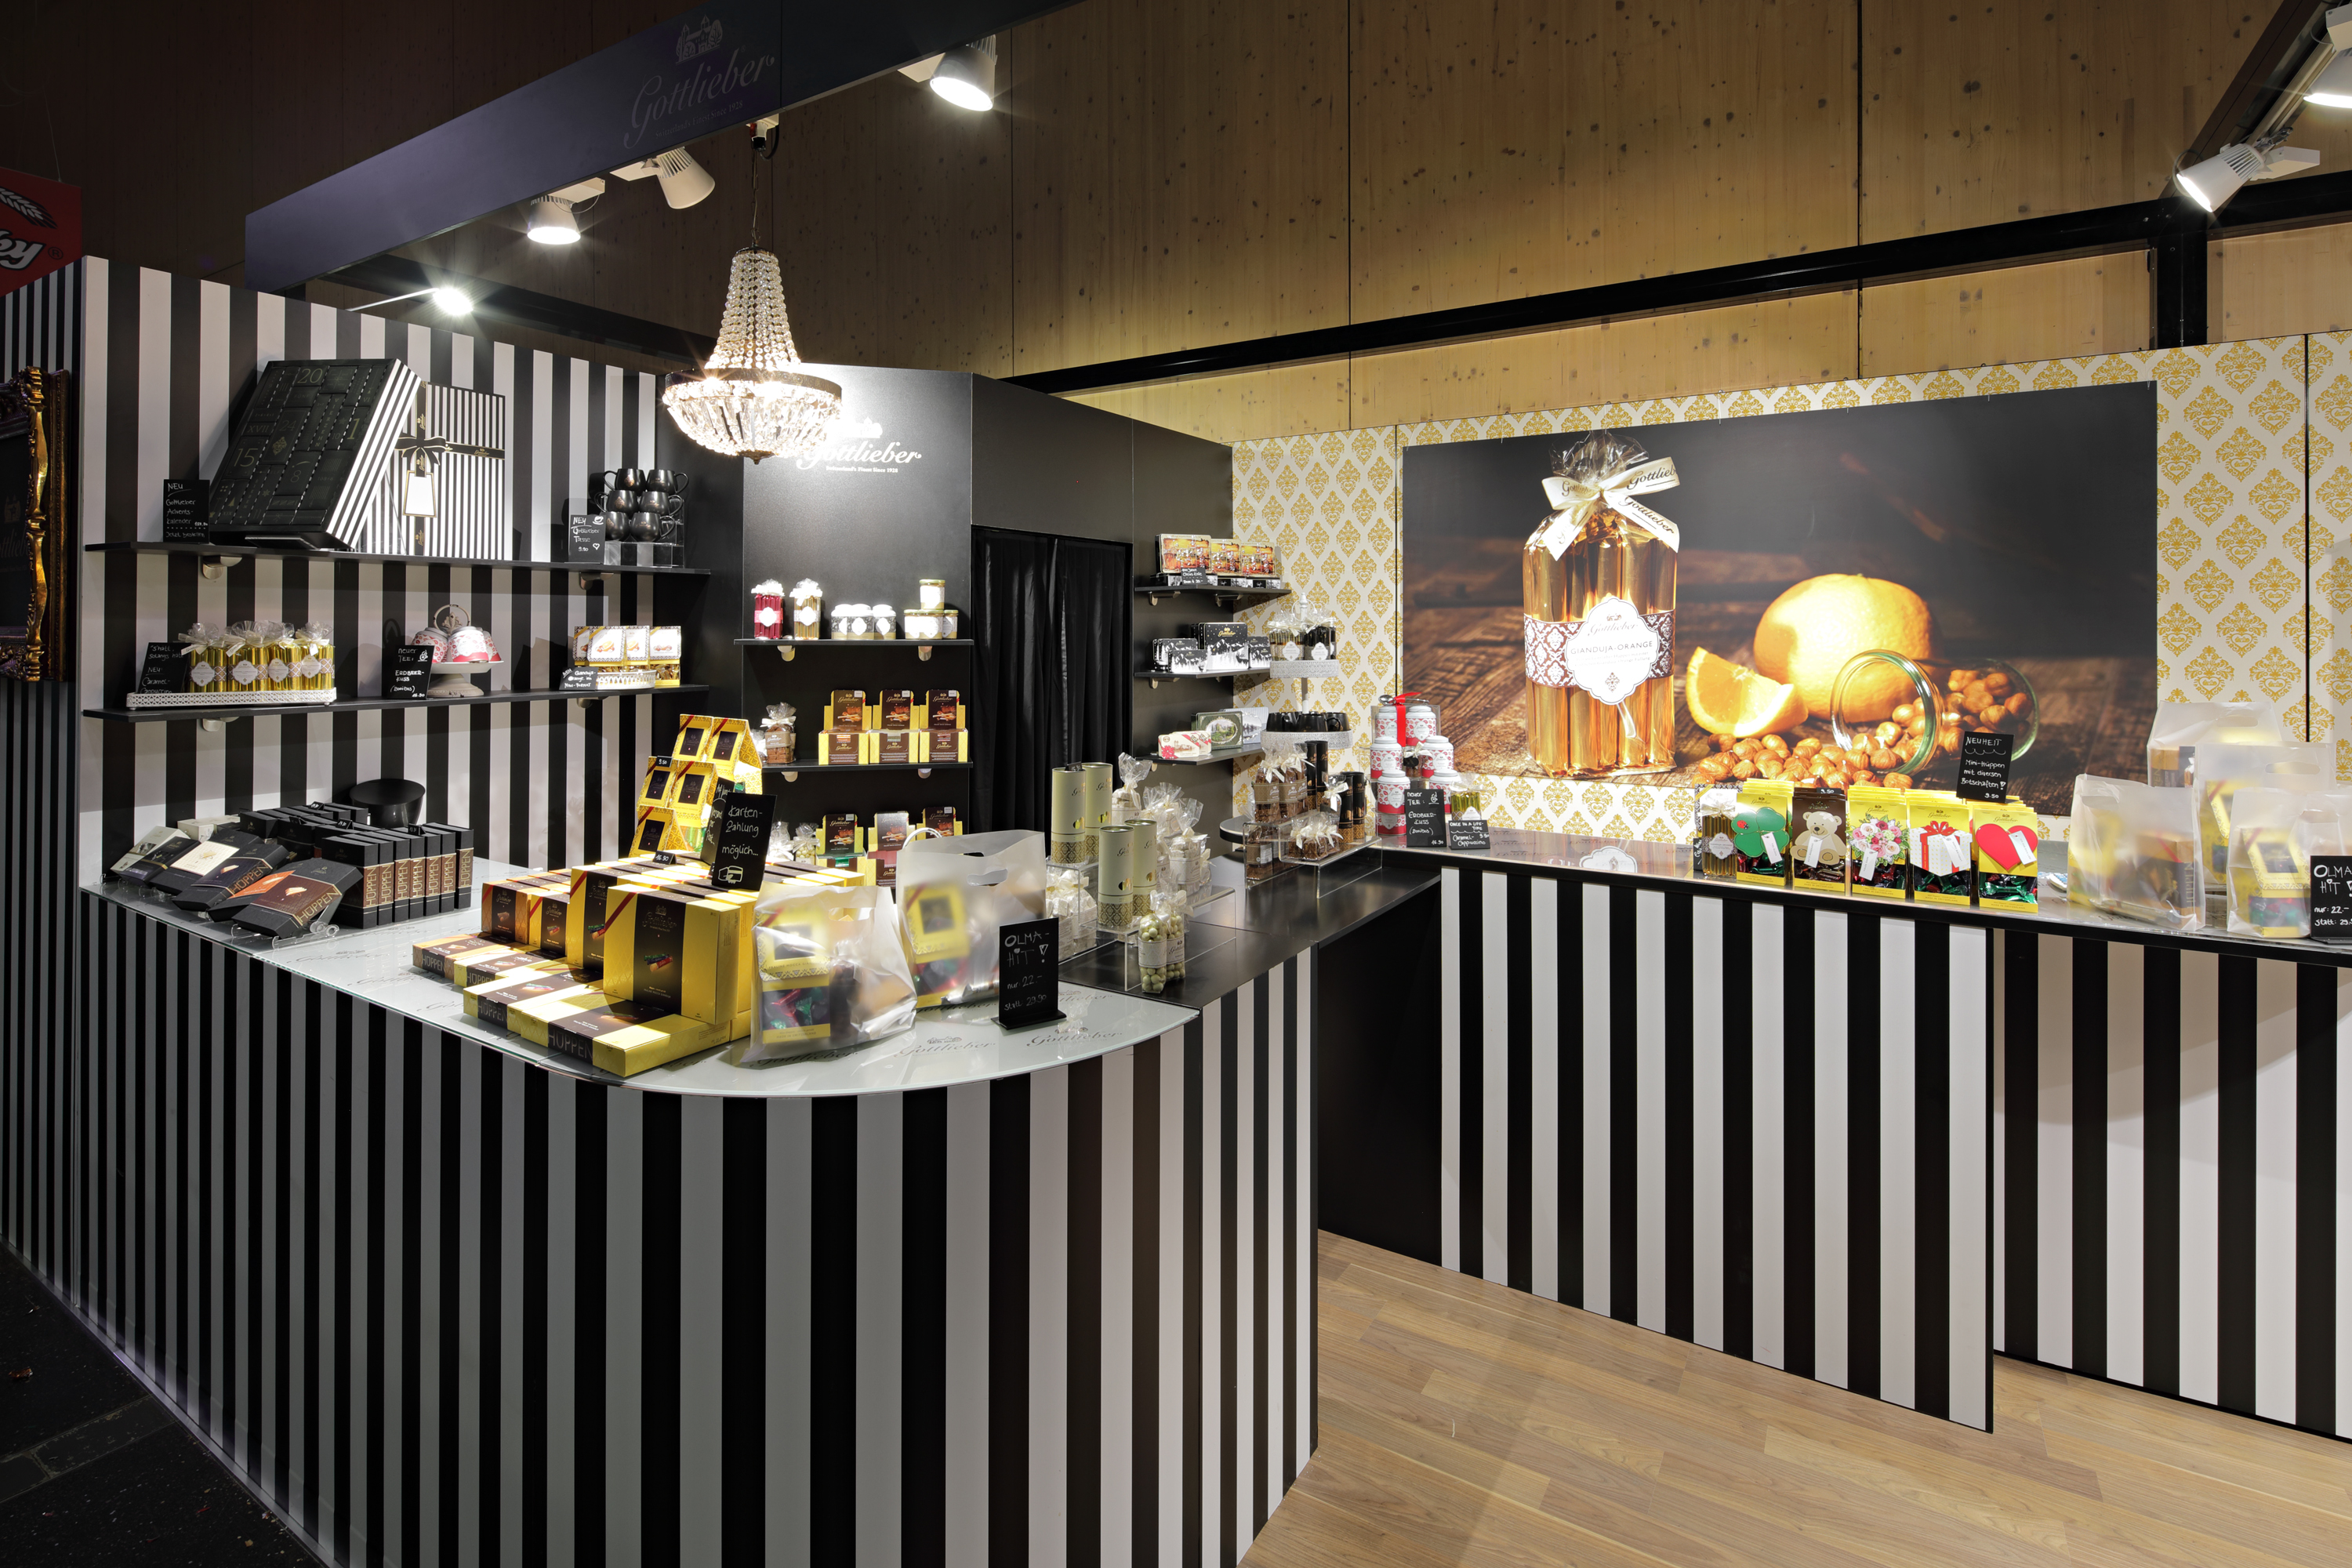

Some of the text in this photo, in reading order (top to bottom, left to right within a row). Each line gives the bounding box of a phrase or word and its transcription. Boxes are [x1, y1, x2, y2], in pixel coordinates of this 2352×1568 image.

[623, 48, 775, 149] Gottlieber
[692, 115, 710, 125] Finest
[710, 108, 727, 119] Since
[728, 100, 743, 112] 1928
[297, 368, 323, 384] 20
[279, 419, 297, 431] 24
[234, 448, 258, 467] 15
[290, 470, 301, 483] 8
[1626, 464, 1677, 490] Gottlieb
[167, 483, 183, 492] NEU
[1618, 495, 1675, 534] Gottlieber
[1570, 641, 1653, 654] GIANDUJA-ORANGE
[1965, 736, 2002, 746] NEUHEIT
[728, 805, 763, 818] Karten-
[725, 820, 759, 838] Zahlung
[1004, 931, 1050, 947] OLMA-
